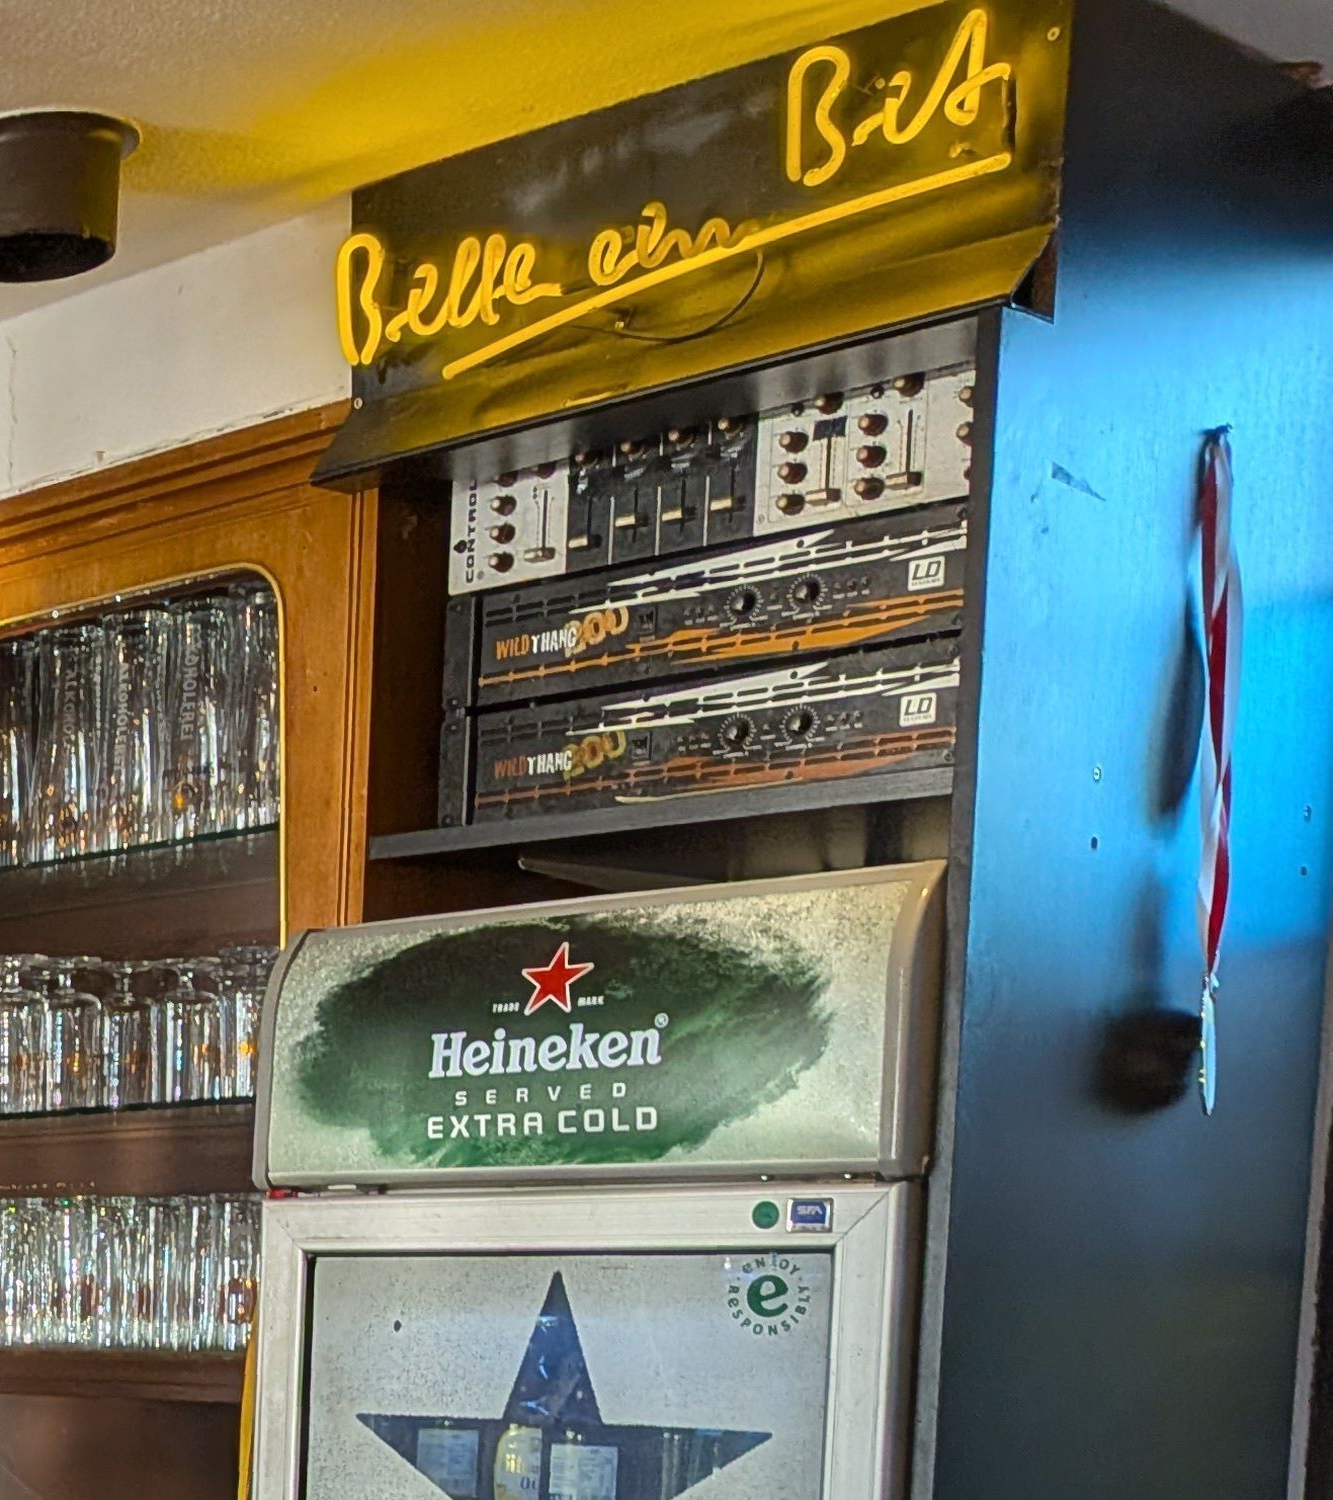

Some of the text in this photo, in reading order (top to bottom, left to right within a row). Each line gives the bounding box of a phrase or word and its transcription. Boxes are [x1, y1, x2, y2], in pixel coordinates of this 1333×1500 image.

[428, 1022, 663, 1079] Heineken
[454, 1082, 627, 1106] SERVED
[427, 1106, 658, 1140] EXTRA COLD
